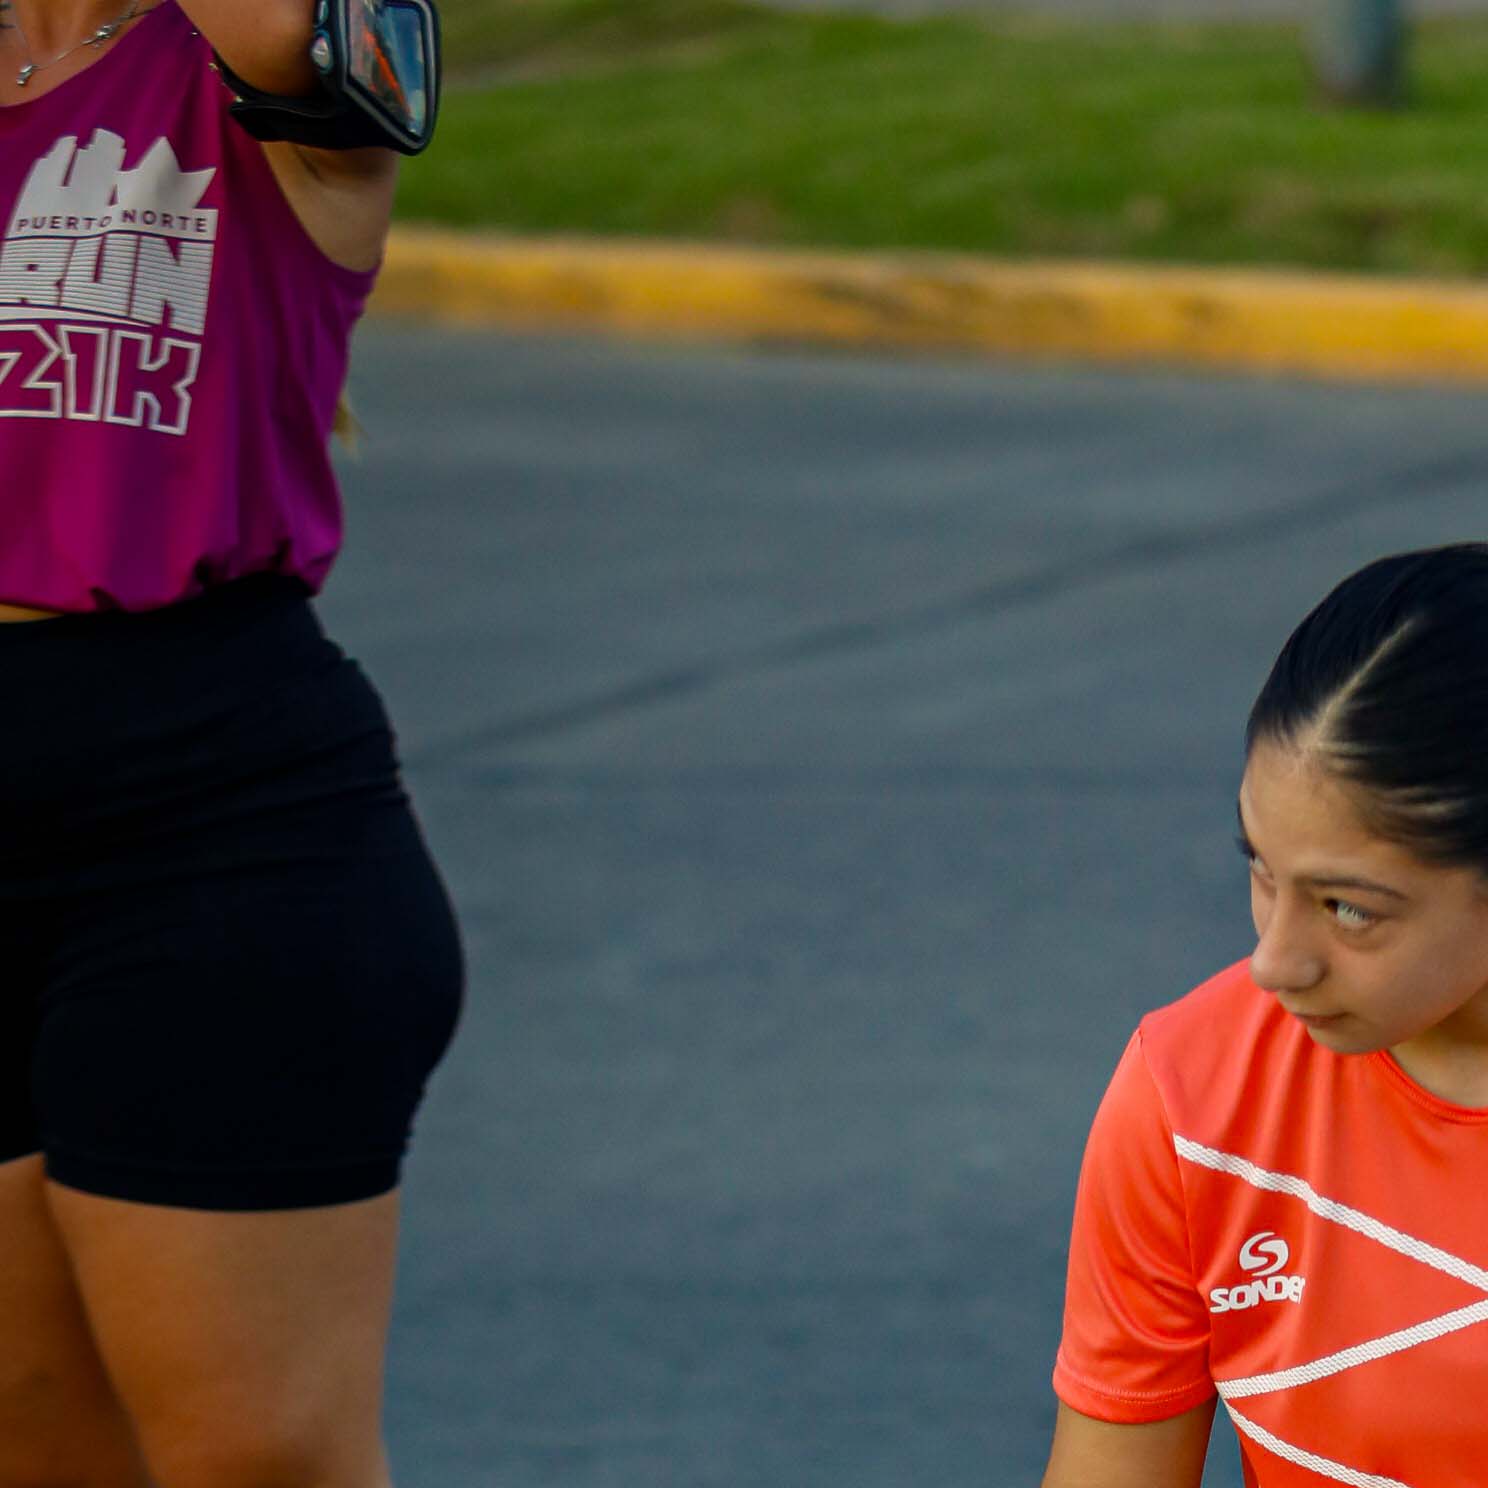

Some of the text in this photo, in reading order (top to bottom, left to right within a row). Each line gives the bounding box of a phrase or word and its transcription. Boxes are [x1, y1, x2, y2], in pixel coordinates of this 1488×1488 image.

[17, 208, 208, 233] PUERTO NORTE
[0, 234, 215, 336] RUN
[0, 323, 202, 436] 21K
